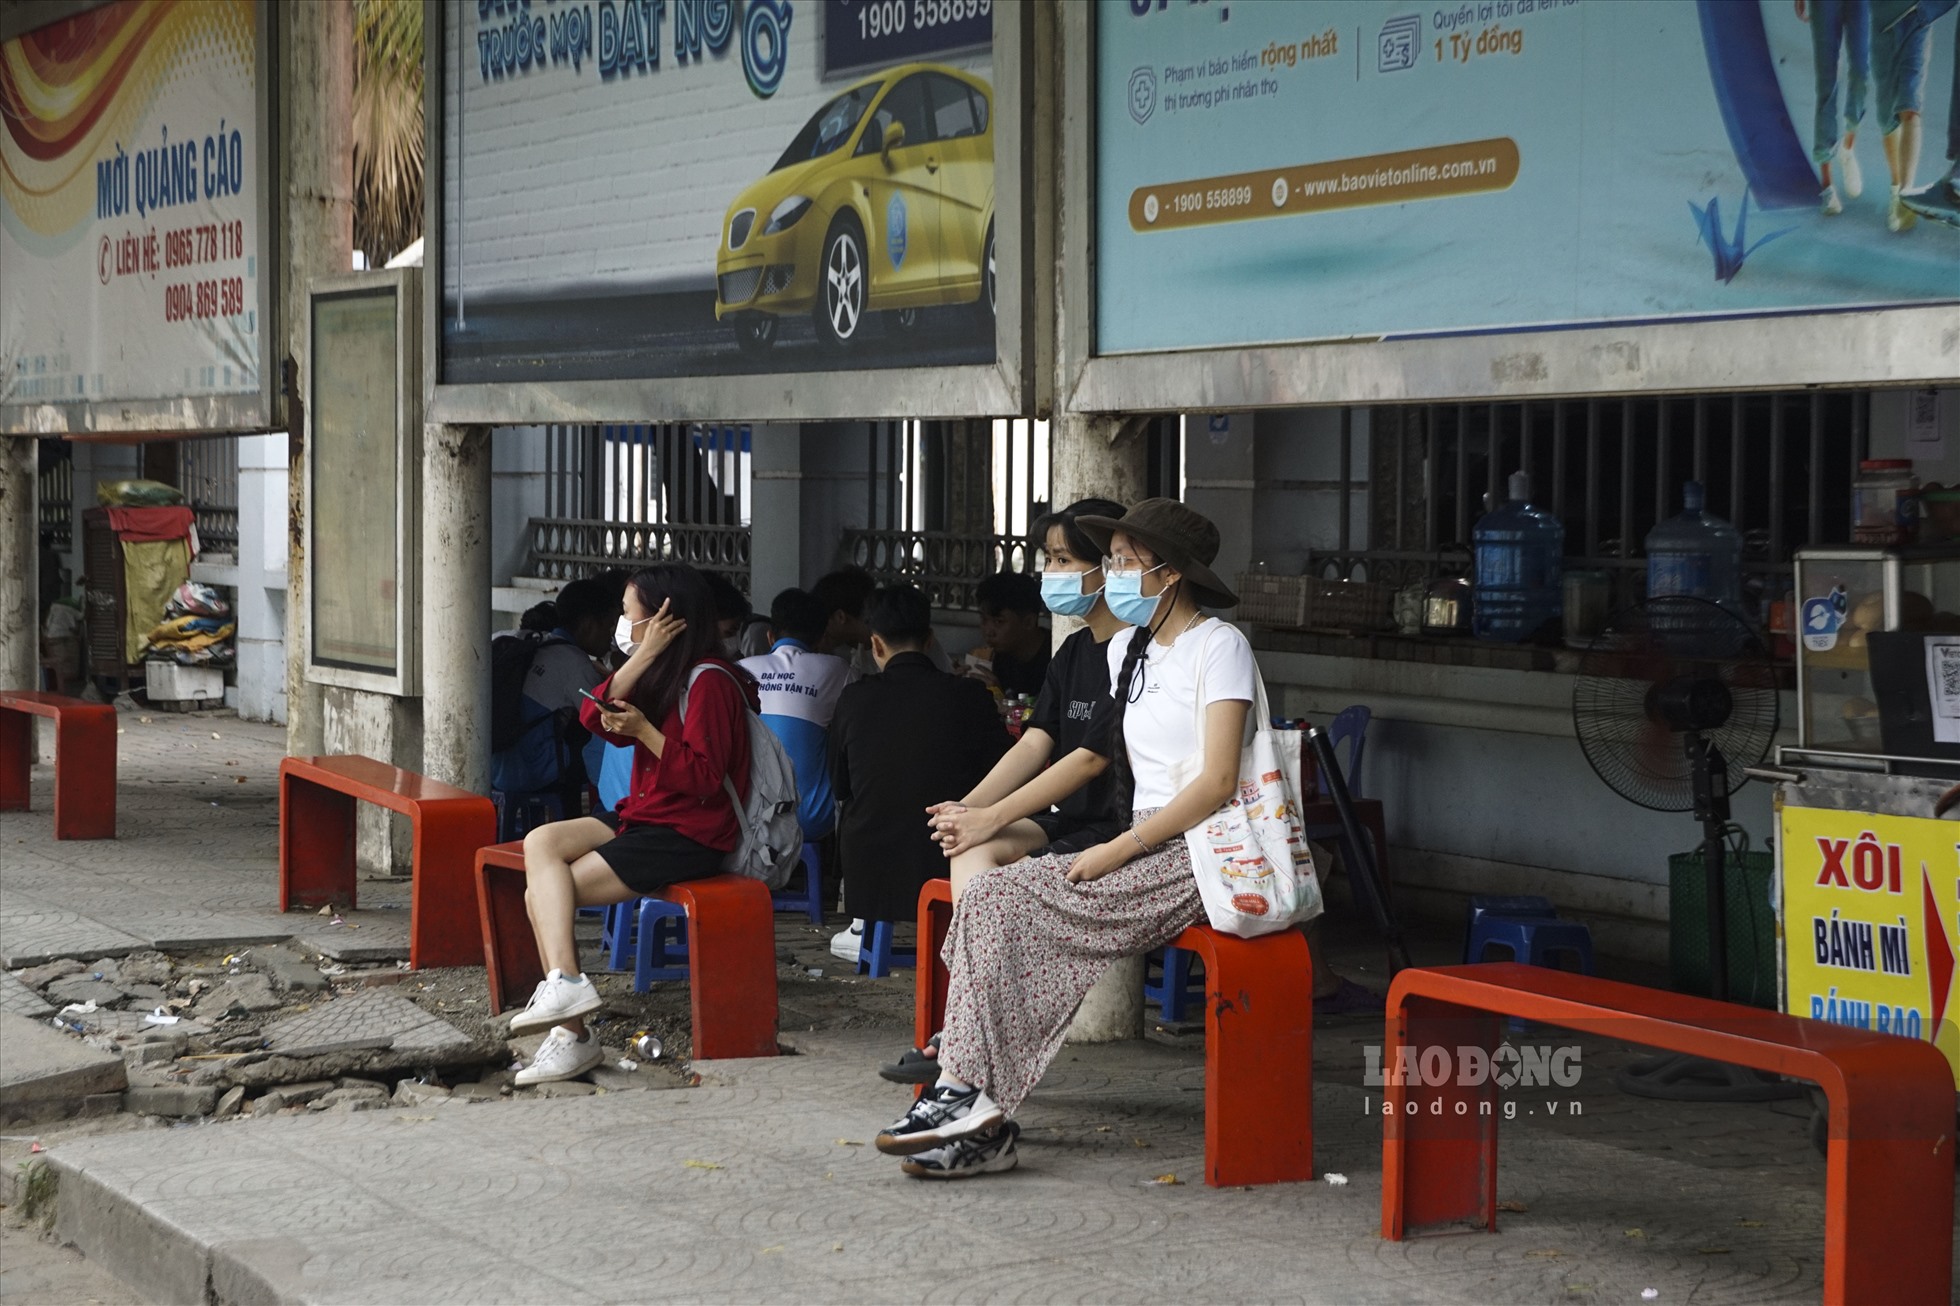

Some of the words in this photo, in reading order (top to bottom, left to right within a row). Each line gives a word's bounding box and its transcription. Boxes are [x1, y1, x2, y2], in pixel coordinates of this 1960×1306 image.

[858, 1, 906, 40] 1900
[1433, 5, 1474, 31] Quyền
[1478, 3, 1493, 26] lợi
[478, 10, 546, 77] TRƯỚC
[550, 5, 593, 68] MỌI
[1164, 67, 1194, 87] Phạm
[1198, 64, 1206, 79] vi
[1208, 59, 1228, 77] bảo
[1231, 50, 1258, 73] hiểm
[1261, 41, 1297, 72] rộng
[1301, 28, 1338, 60] nhất
[1434, 38, 1443, 62] 1
[1450, 31, 1471, 63] Tỷ
[1476, 24, 1522, 56] đồng
[1164, 96, 1177, 115] thị
[1179, 88, 1211, 109] trường
[1214, 85, 1230, 107] phi
[1232, 80, 1258, 100] nhân
[1261, 78, 1278, 98] thọ
[97, 140, 130, 219] MỜI
[136, 124, 197, 219] QUẢNG
[203, 118, 243, 199] CÁO
[1304, 156, 1496, 197] www.baovietonline.com.vn
[1174, 191, 1202, 213] 1900
[1206, 186, 1252, 210] 558899
[116, 230, 140, 276] LIÊN
[143, 227, 160, 280] HỆ:
[165, 229, 193, 269] 0965
[196, 224, 217, 263] 778
[221, 220, 243, 260] 118
[165, 284, 193, 322] 0904
[196, 281, 218, 319] 869
[221, 277, 243, 317] 589
[759, 682, 782, 691] HÔNG
[785, 683, 803, 694] VẬN
[805, 684, 818, 698] TẢI
[761, 672, 775, 681] ĐẠI
[777, 672, 795, 681] HỌC
[1815, 830, 1902, 895] XÔI
[1813, 909, 1876, 972] BÁNH
[1878, 916, 1911, 977] MÌ
